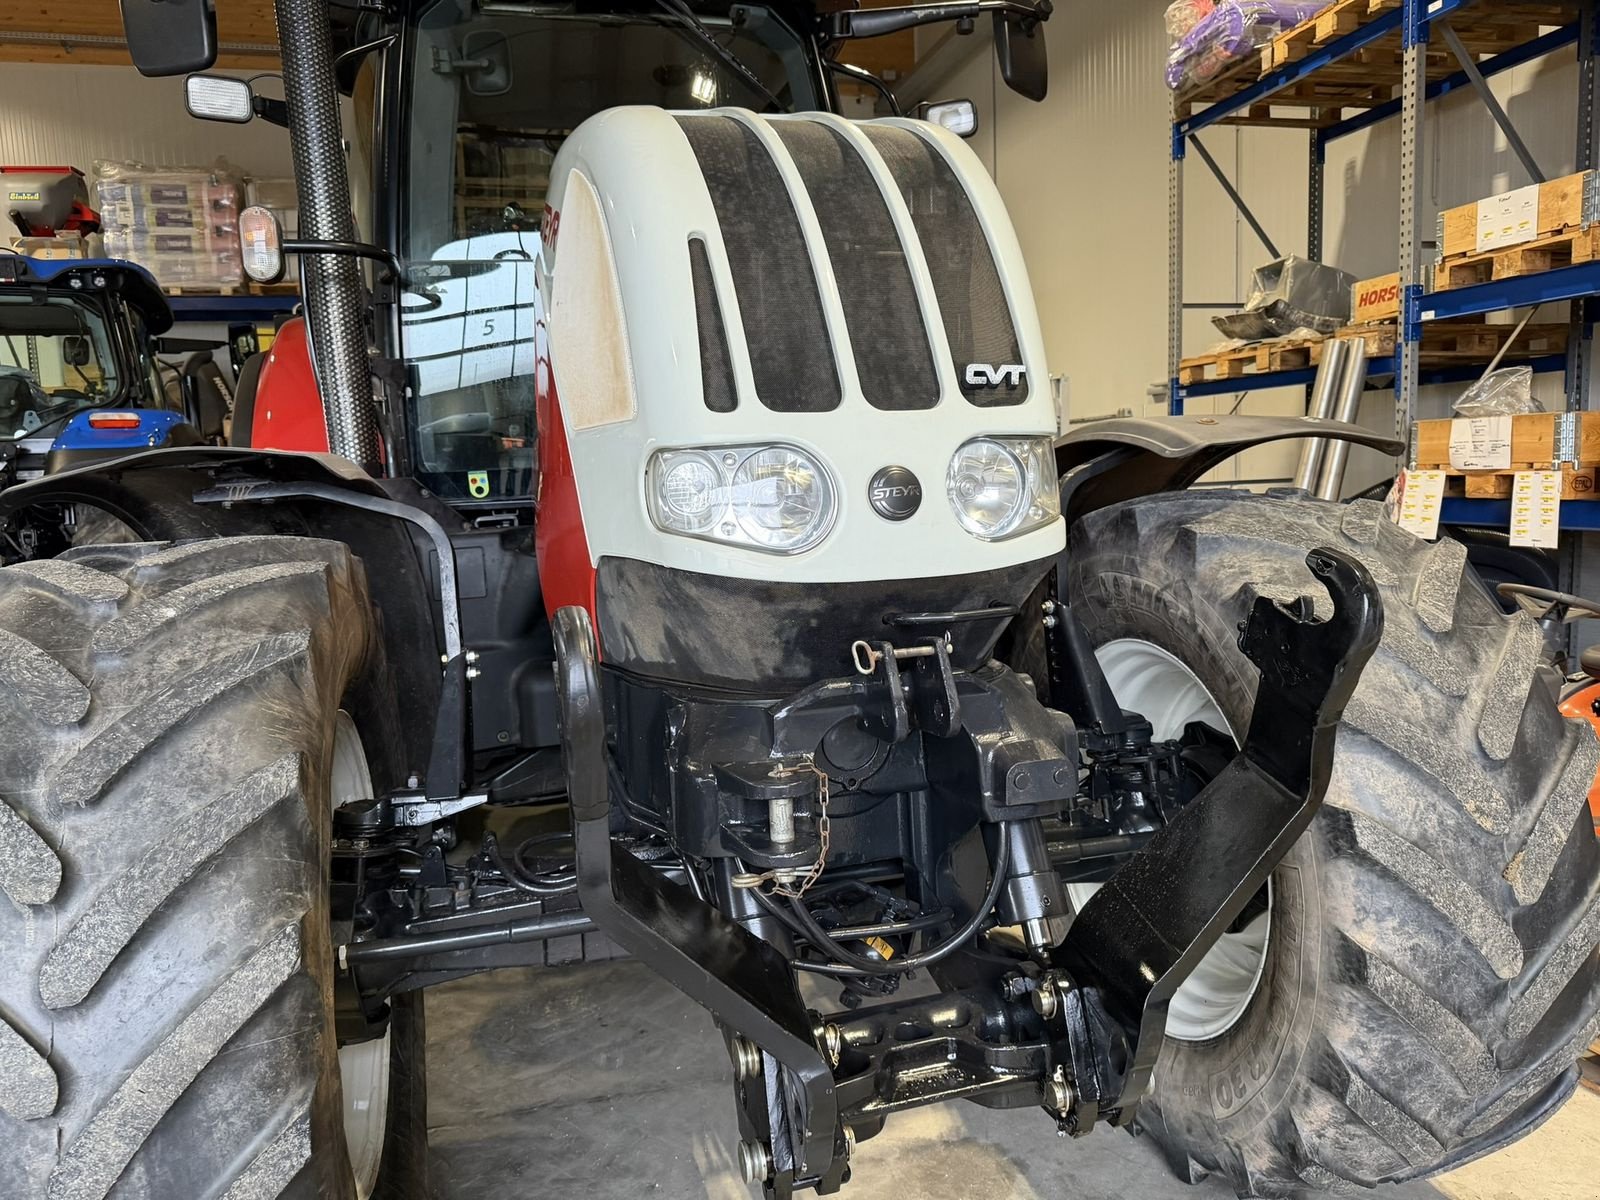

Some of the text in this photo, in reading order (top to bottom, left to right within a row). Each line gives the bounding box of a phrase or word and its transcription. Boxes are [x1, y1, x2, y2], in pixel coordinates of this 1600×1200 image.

[965, 363, 1026, 387] CVT
[872, 484, 920, 500] STEYR
[1574, 479, 1590, 489] EPAL
